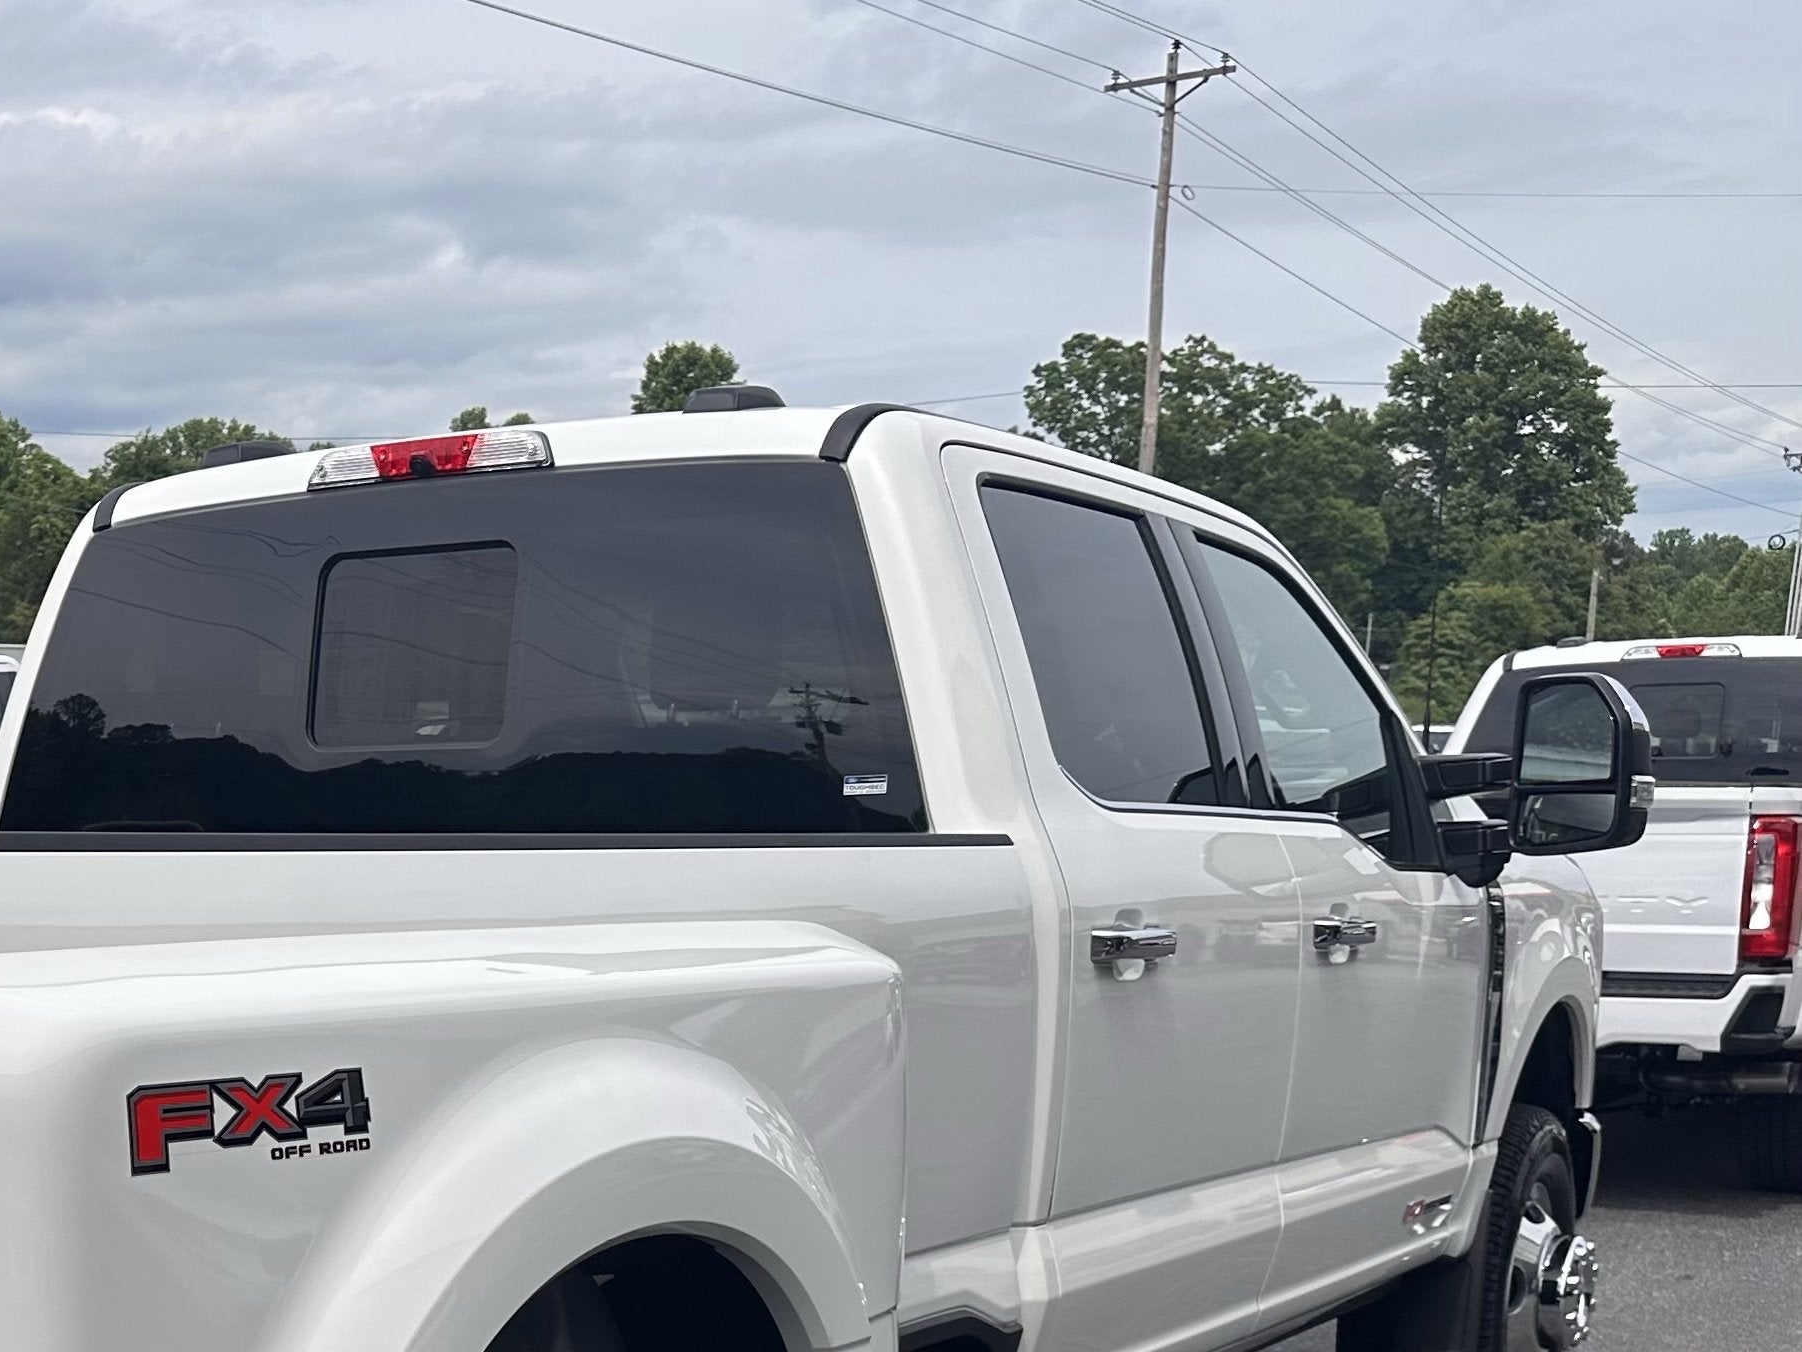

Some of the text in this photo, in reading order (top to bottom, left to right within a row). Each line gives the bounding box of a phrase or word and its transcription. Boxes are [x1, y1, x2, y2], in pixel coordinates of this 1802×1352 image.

[126, 1067, 371, 1176] FX4
[270, 1137, 371, 1160] OFF ROAD
